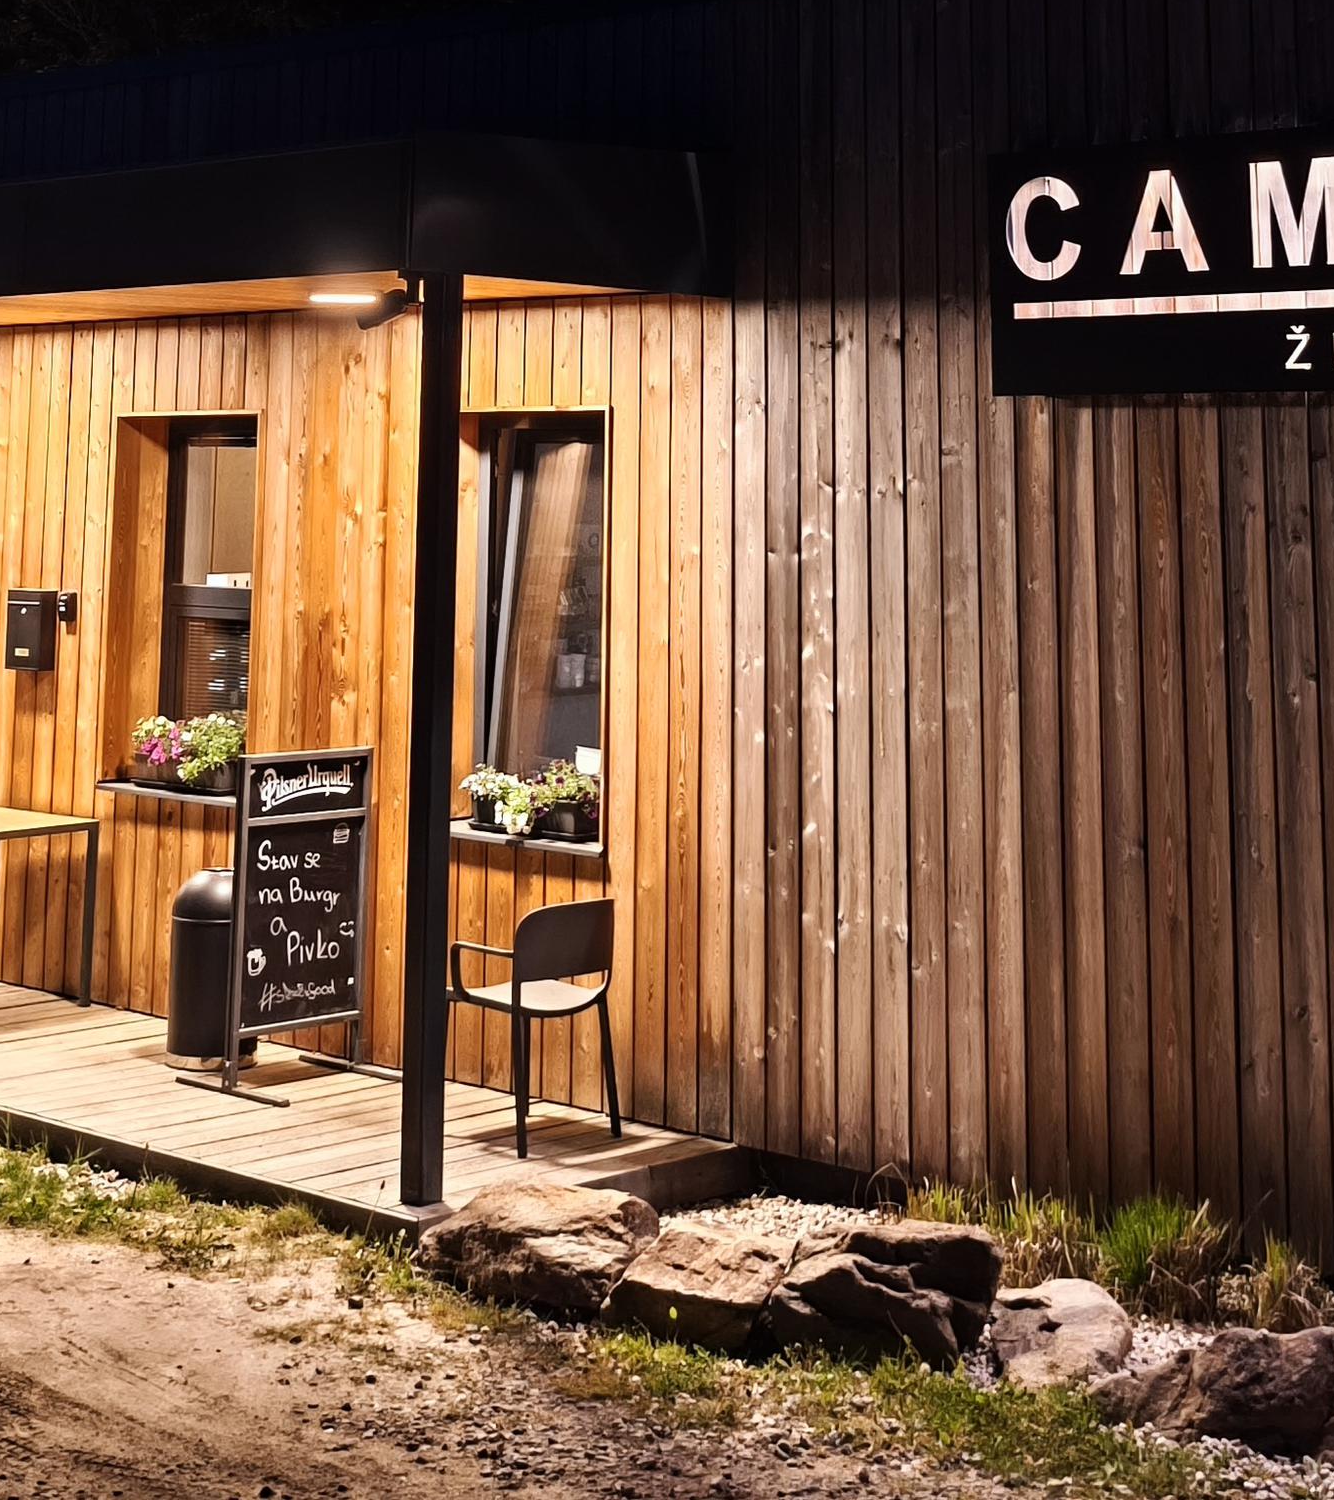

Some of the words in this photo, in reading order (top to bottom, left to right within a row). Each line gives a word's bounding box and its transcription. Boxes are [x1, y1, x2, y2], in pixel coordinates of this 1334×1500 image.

[258, 767, 308, 812] Pilsner
[257, 839, 298, 871] Stav
[303, 852, 321, 868] se
[258, 888, 284, 905] na
[289, 877, 341, 912] Burgr
[270, 916, 288, 936] a
[287, 928, 340, 967] Pivko
